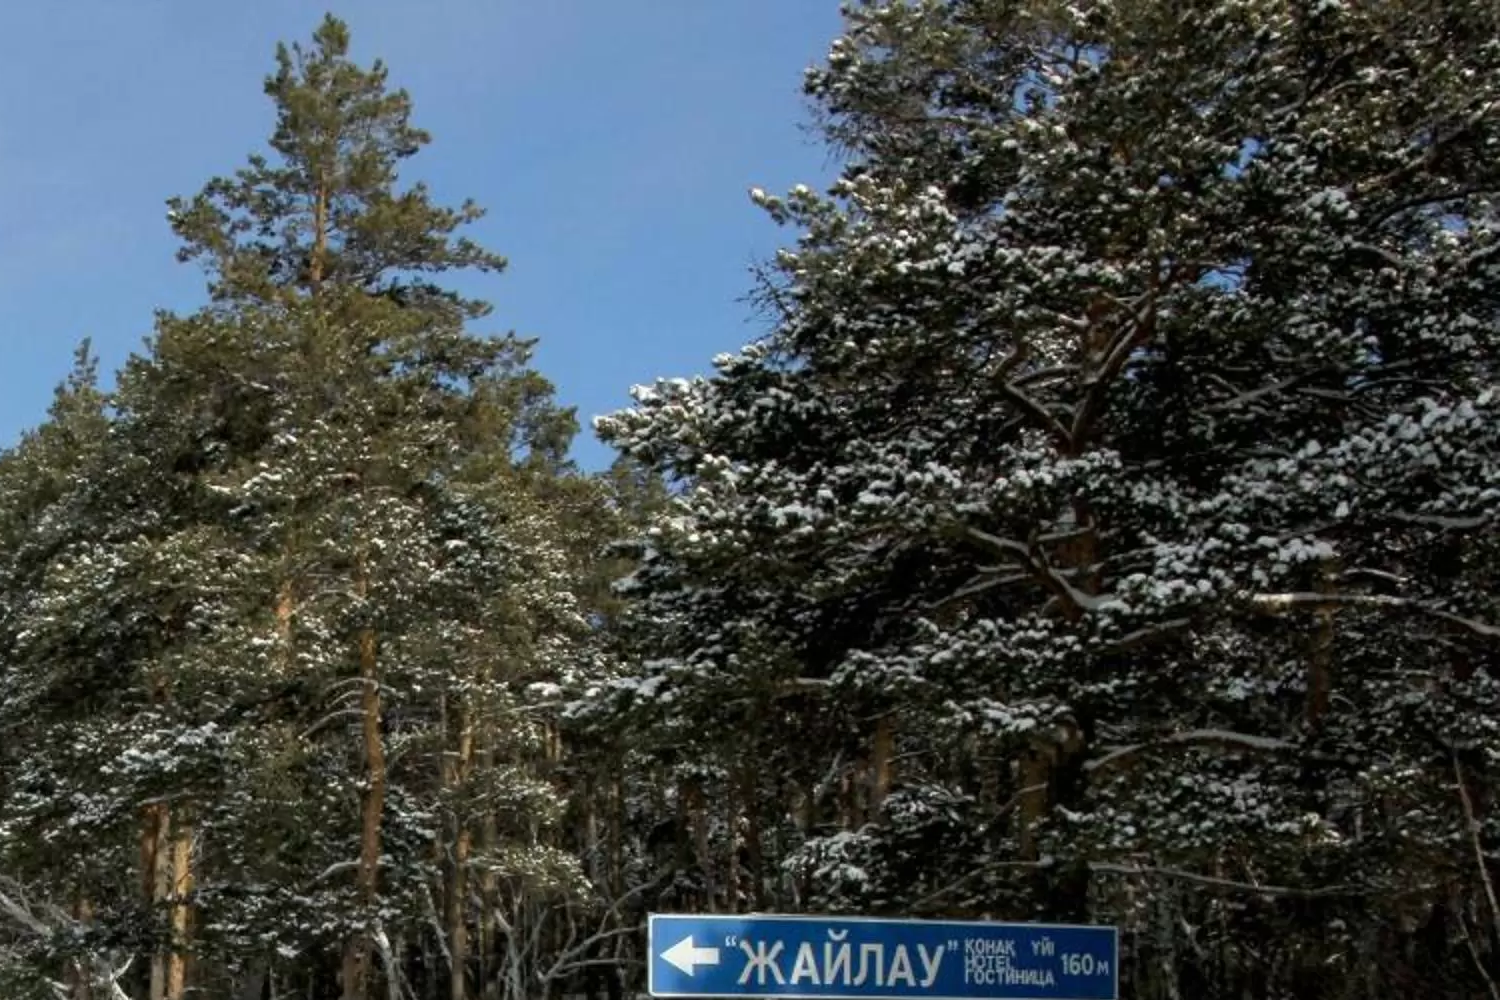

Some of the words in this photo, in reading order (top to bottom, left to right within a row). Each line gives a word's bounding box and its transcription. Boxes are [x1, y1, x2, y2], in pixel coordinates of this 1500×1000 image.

[964, 955, 1013, 970] HOTEL
[1061, 953, 1094, 976] 160
[964, 969, 1055, 987] ГОСТИНИЦА
